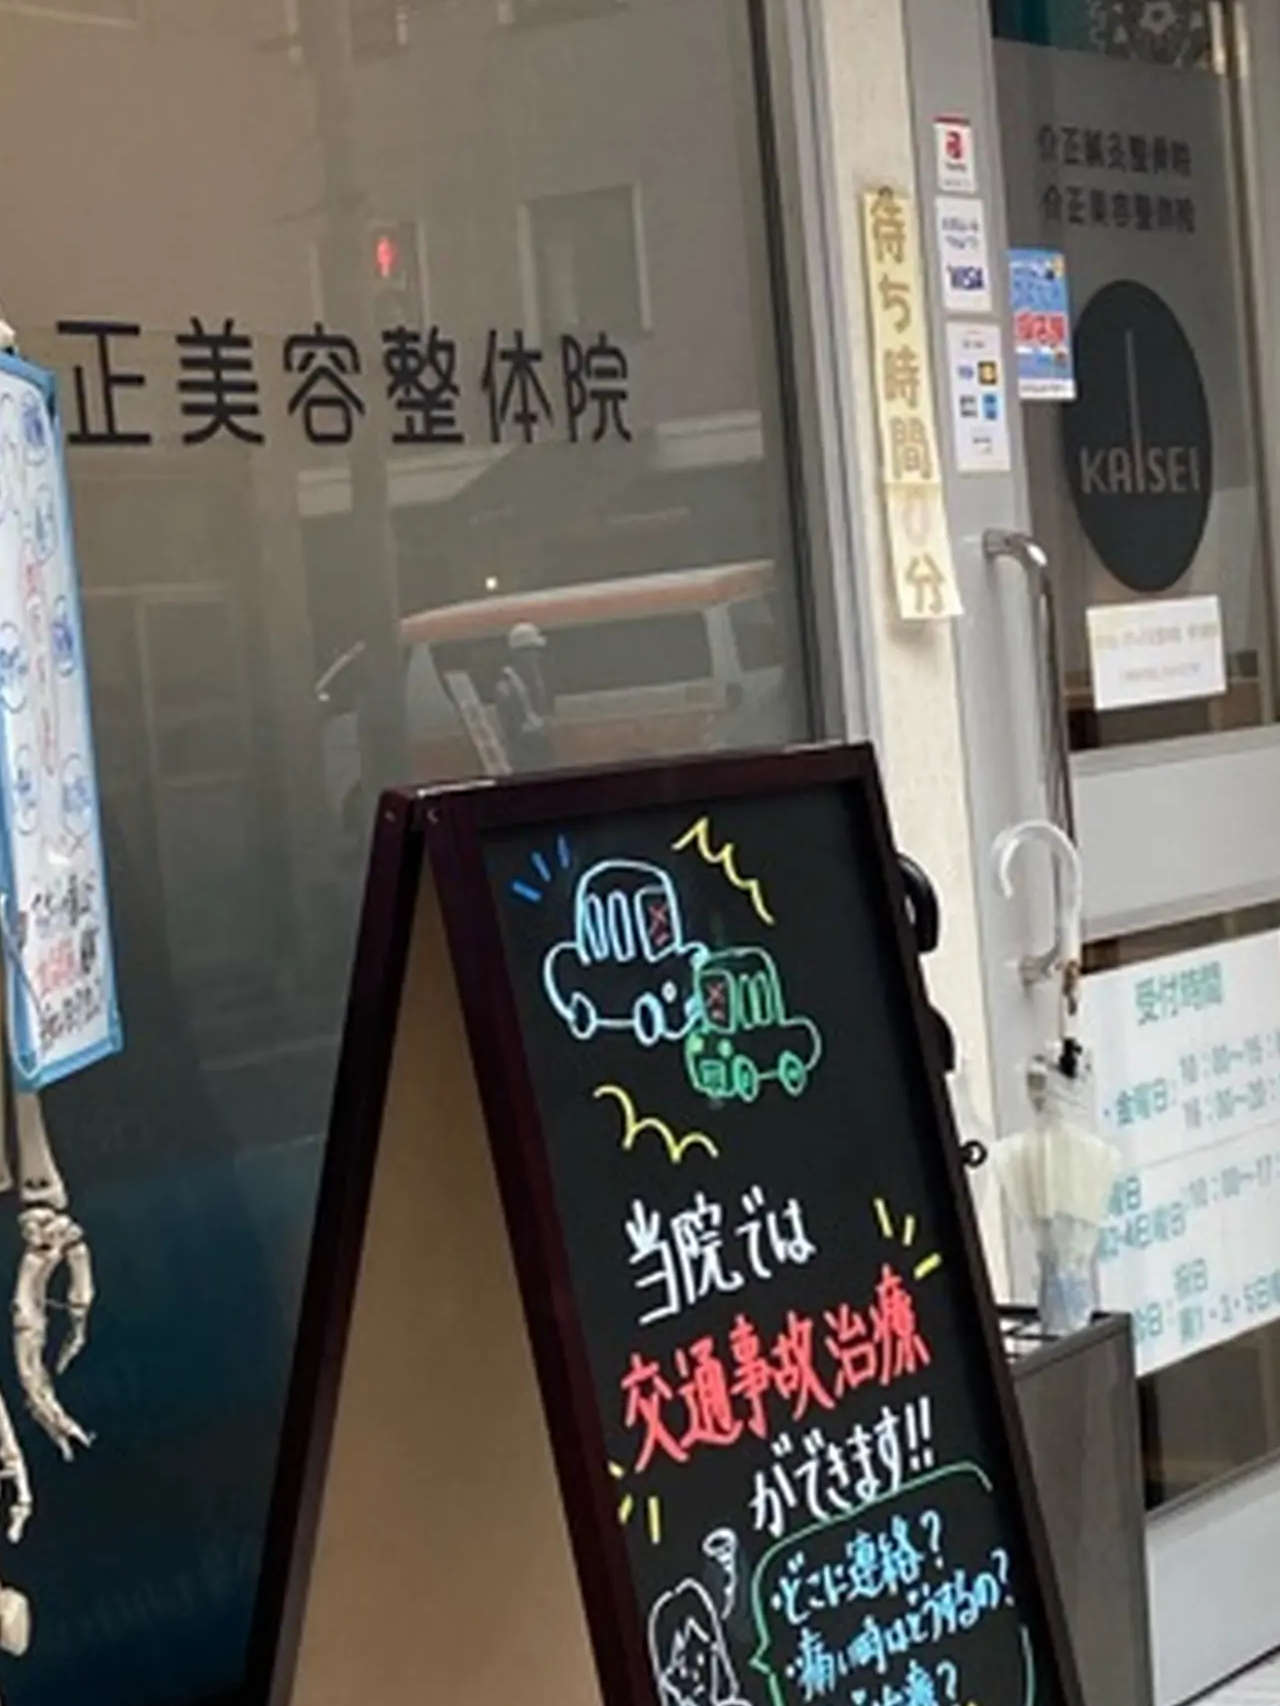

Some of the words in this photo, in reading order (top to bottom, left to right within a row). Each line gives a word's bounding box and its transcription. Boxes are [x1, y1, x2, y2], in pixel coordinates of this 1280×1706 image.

[1079, 445, 1201, 494] KAISEI
[624, 1185, 816, 1325] 当院では
[620, 1263, 932, 1471] 交通事故治療
